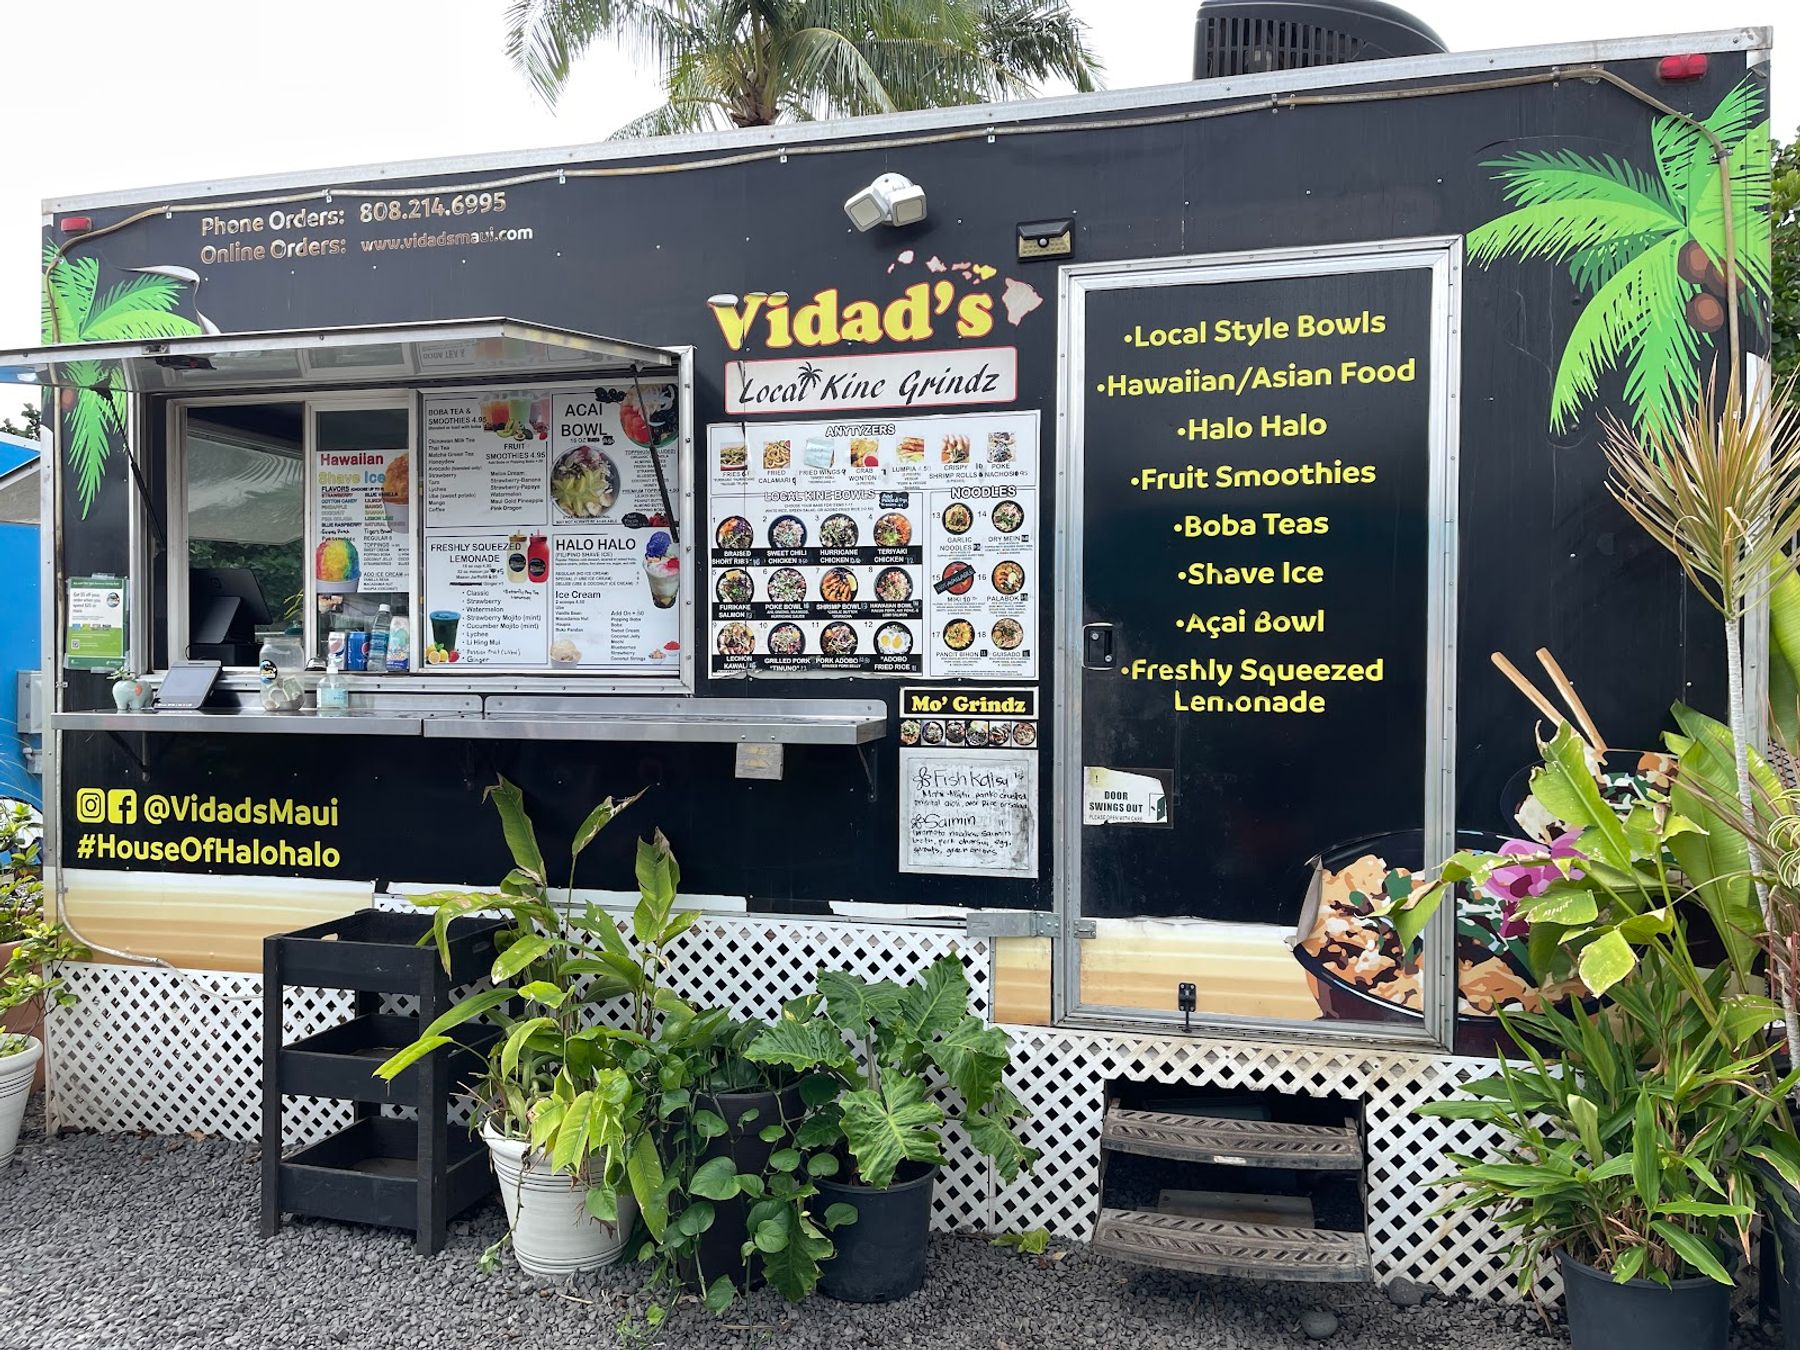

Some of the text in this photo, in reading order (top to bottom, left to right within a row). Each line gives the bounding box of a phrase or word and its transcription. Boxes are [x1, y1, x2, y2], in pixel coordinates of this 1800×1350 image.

[201, 192, 506, 236] Phone Orders: 808.214.6995
[200, 226, 533, 265] Online Orders: www.vidadsmaui.com
[707, 280, 994, 351] Vidad's
[1214, 317, 1290, 346] Style
[1298, 311, 1386, 338] Bowls
[1341, 358, 1416, 385] Food
[738, 364, 1000, 405] Local Kine Grindz
[564, 403, 603, 417] ACAI
[561, 422, 607, 437] BOWL
[825, 422, 896, 437] ANYTYZERS
[1261, 413, 1328, 438] Halo
[320, 453, 384, 466] Hawaiian
[486, 452, 529, 460] SMOOTHIES
[319, 470, 386, 485] Shave Ice
[955, 471, 977, 479] ROLLS
[1216, 459, 1376, 488] Smoothies
[764, 491, 803, 502] LOCAL
[805, 490, 830, 501] KINE
[832, 489, 876, 501] BOWLS
[951, 485, 1017, 499] NOODLES
[1263, 512, 1329, 536] Teas
[430, 542, 521, 552] FRESHLY SQUEEZED
[556, 538, 636, 550] HALO HALO
[449, 555, 500, 563] LEMONADE
[820, 556, 850, 564] CHICKEN
[1283, 561, 1324, 584] Ice
[571, 590, 601, 598] Cream
[466, 598, 501, 606] Strawberry
[503, 614, 521, 622] Mojito
[1254, 609, 1325, 633] Bowl
[1240, 658, 1384, 687] Squeezed
[952, 696, 1026, 713] Grindz
[1174, 689, 1326, 713] Lemonade
[933, 768, 967, 787] Fish
[1104, 790, 1129, 800] DOOR
[143, 793, 339, 826] @VidadsMaui
[1089, 802, 1143, 813] SWINGS OUT
[924, 814, 977, 829] Saimin
[77, 833, 341, 868] #HouseOfHalohalo
